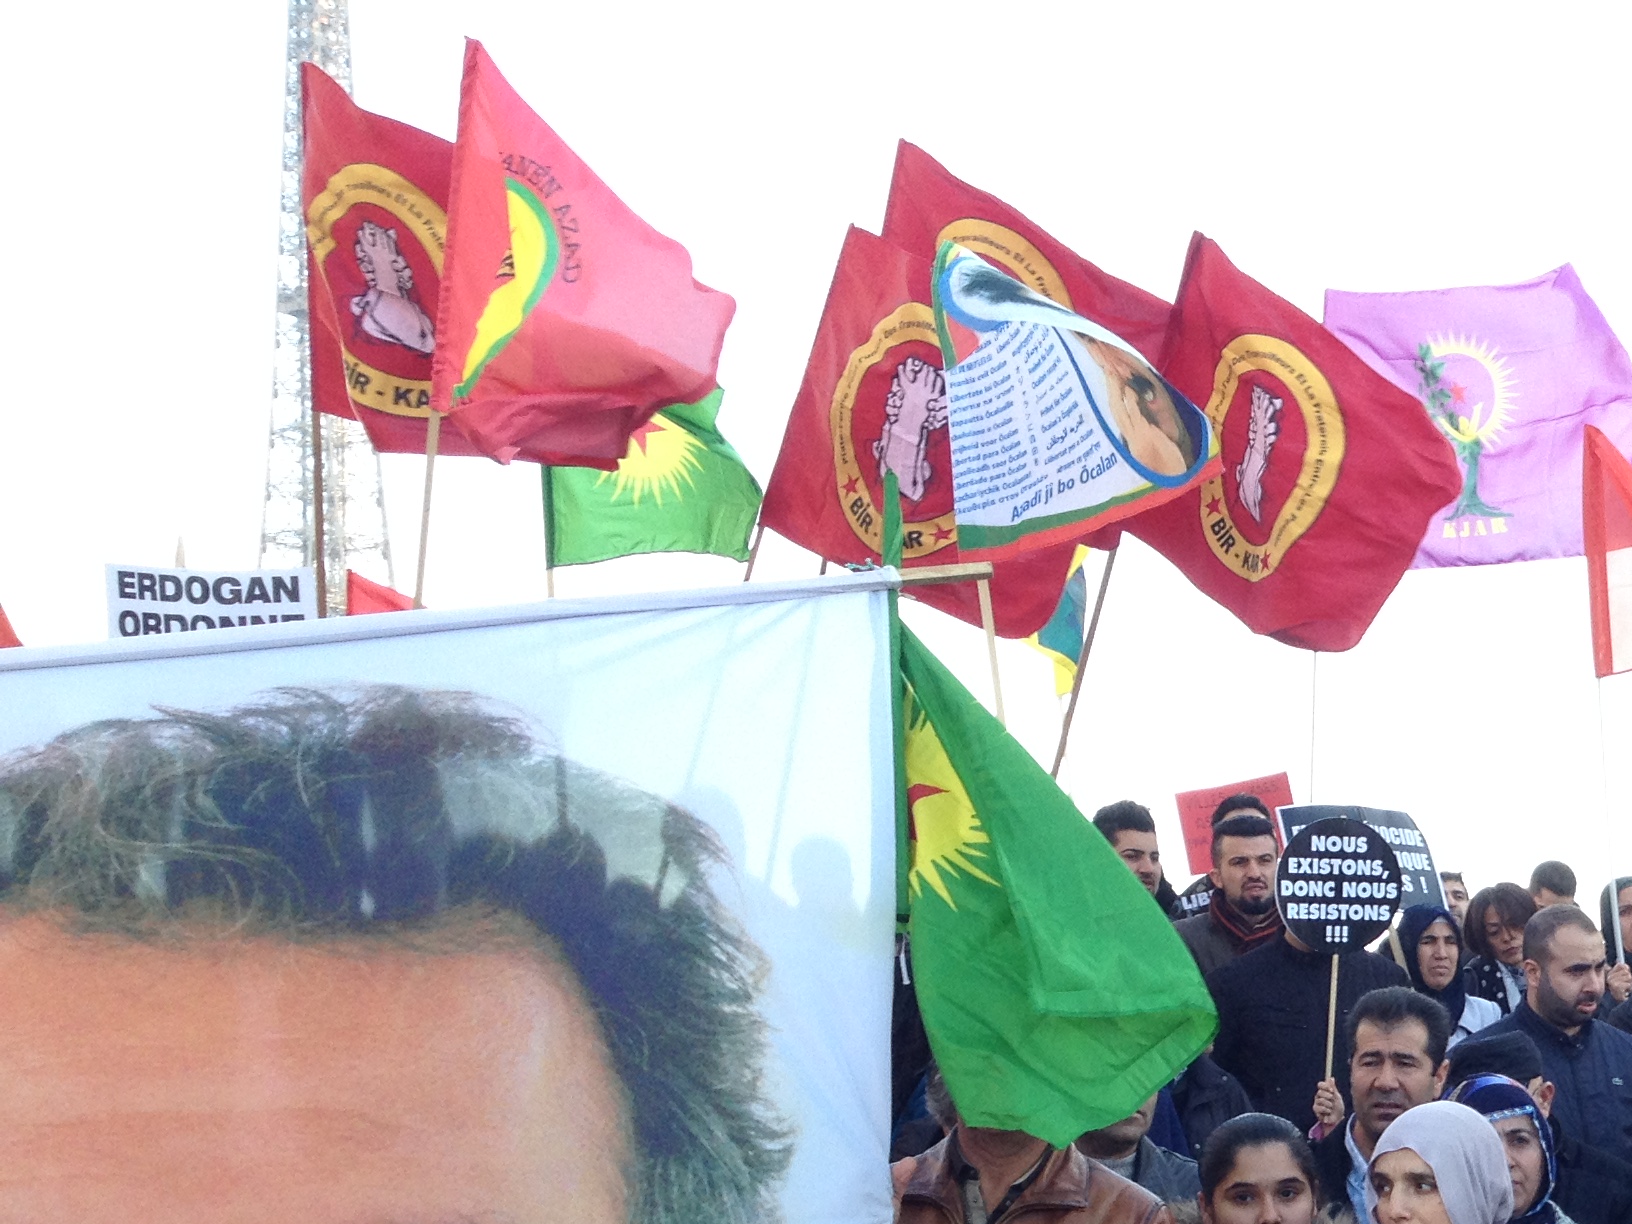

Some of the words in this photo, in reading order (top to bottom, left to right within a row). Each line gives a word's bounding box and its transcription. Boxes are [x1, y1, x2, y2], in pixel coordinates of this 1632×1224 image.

[393, 386, 430, 408] KA
[1057, 478, 1075, 495] bo
[1079, 451, 1118, 485] Öcalan
[901, 530, 924, 550] AR
[1210, 518, 1236, 555] BİR
[117, 570, 301, 606] ERDOGAN
[1311, 835, 1368, 853] NOUS
[1288, 857, 1390, 880] EXISTONS,
[1280, 880, 1336, 897] DONC
[1342, 881, 1398, 899] NOUS
[1286, 902, 1391, 921] RESISTONS
[1325, 925, 1349, 943] !!!
